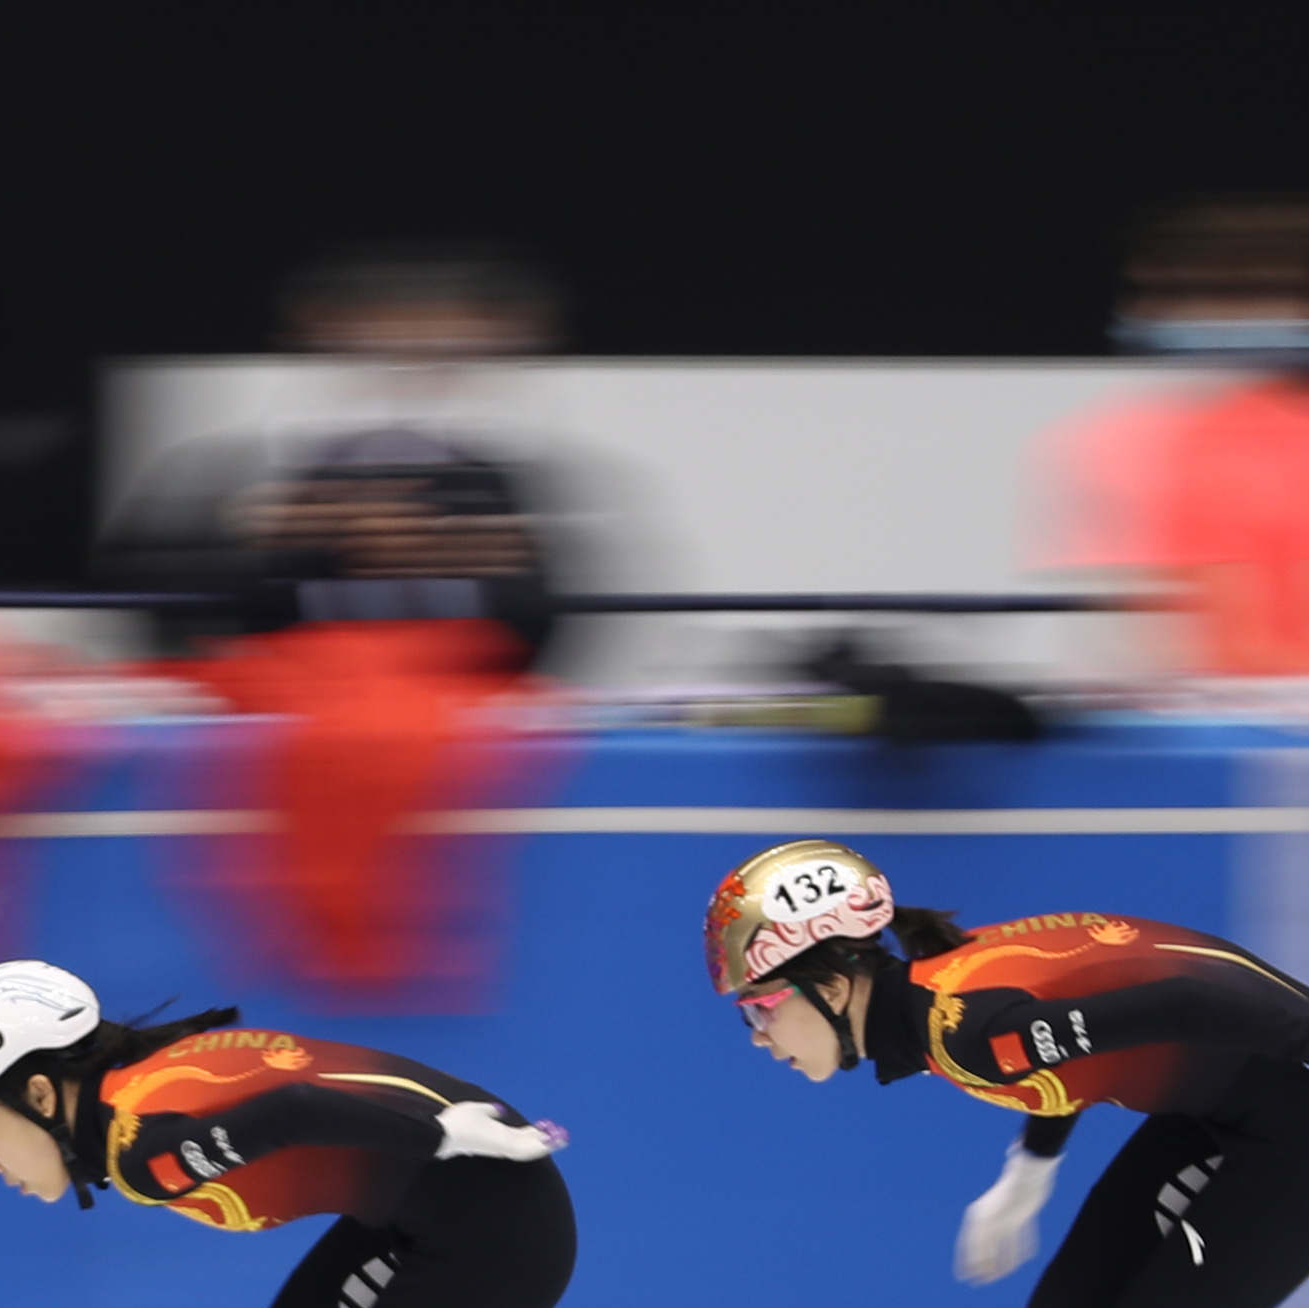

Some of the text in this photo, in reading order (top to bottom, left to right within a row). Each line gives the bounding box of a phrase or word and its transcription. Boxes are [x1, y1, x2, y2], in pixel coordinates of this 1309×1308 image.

[775, 866, 846, 912] 132
[977, 912, 1109, 944] CHINA
[167, 1031, 296, 1058] CHINA
